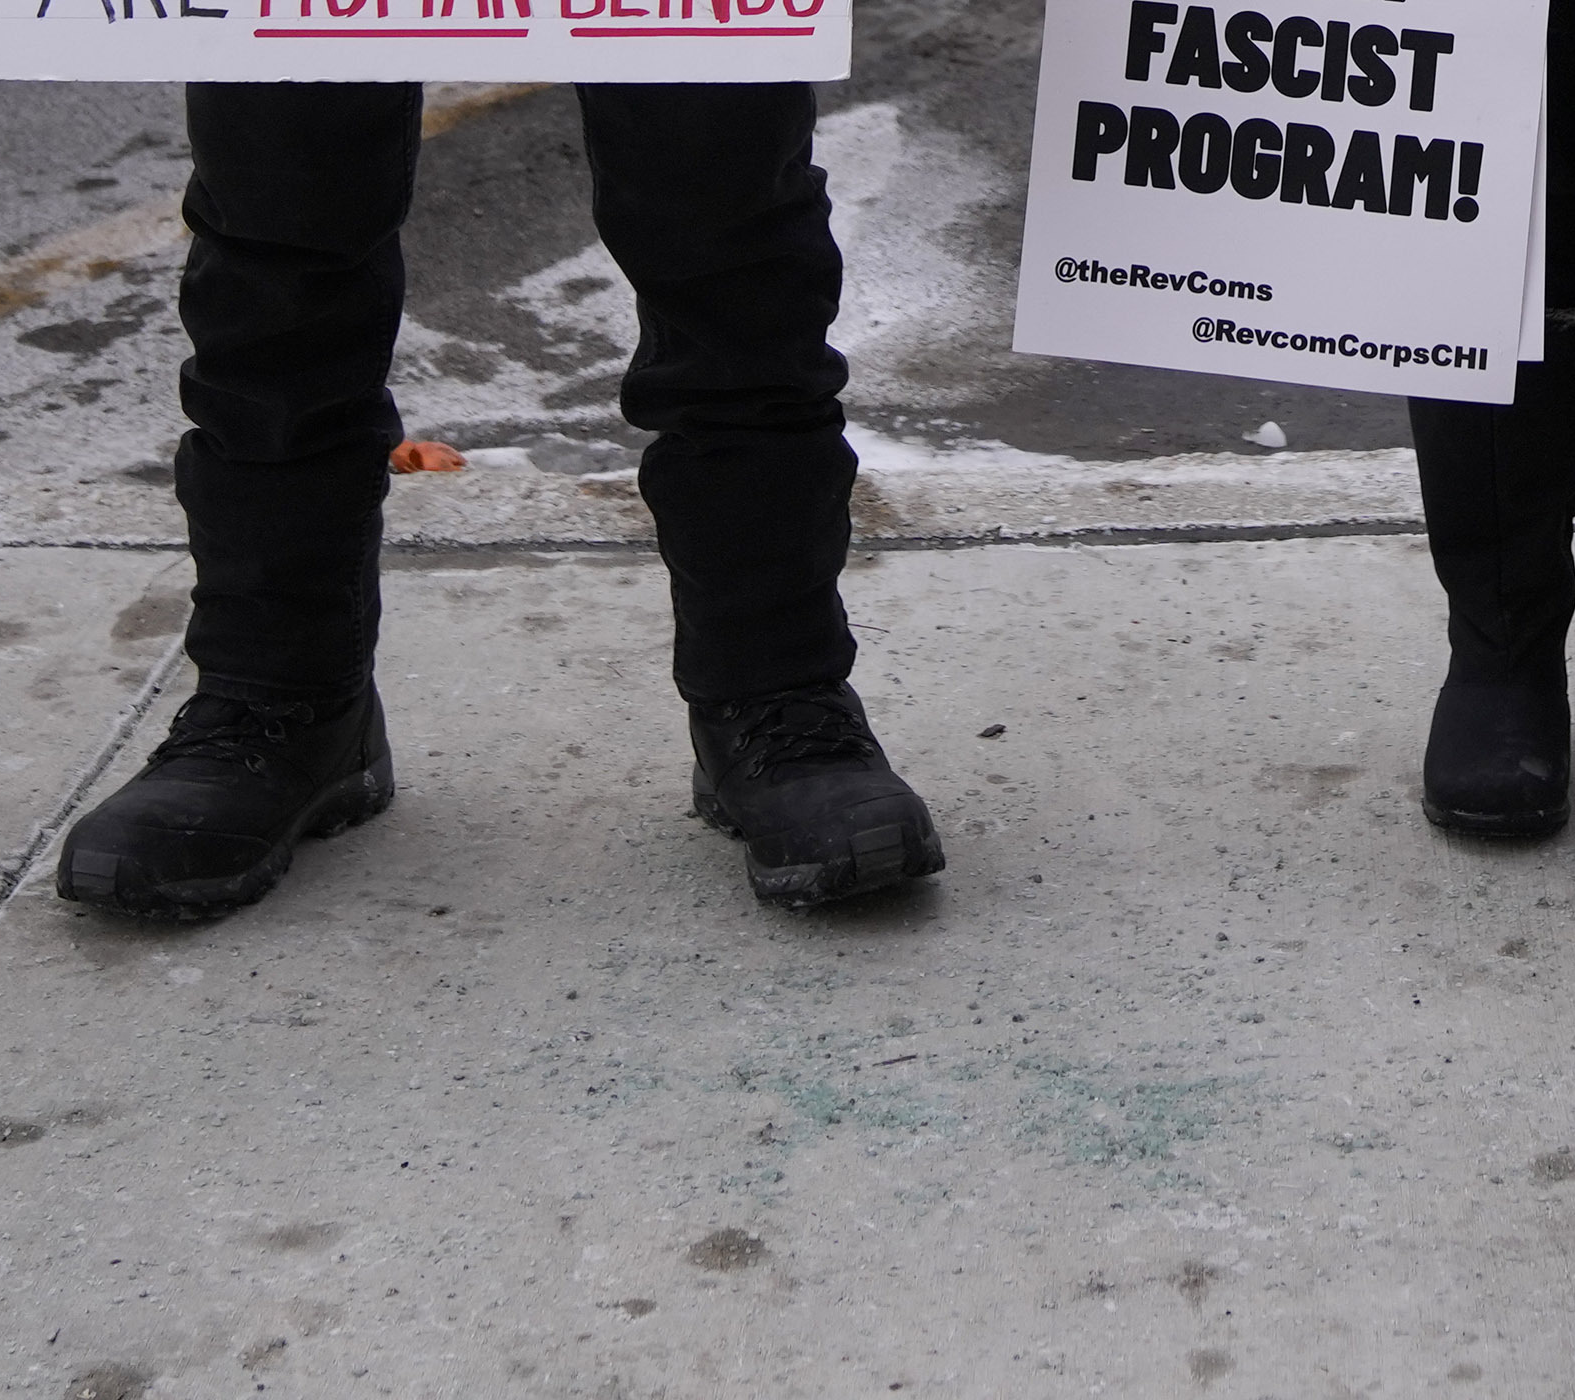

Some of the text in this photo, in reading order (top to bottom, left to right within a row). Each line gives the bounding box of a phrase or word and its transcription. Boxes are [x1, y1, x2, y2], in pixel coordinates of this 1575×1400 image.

[1124, 0, 1455, 113] FASCIST
[1071, 99, 1485, 224] PROGRAM!
[1054, 256, 1274, 303] @theRevComs
[1191, 316, 1489, 373] @RevcomCorpsCHI
